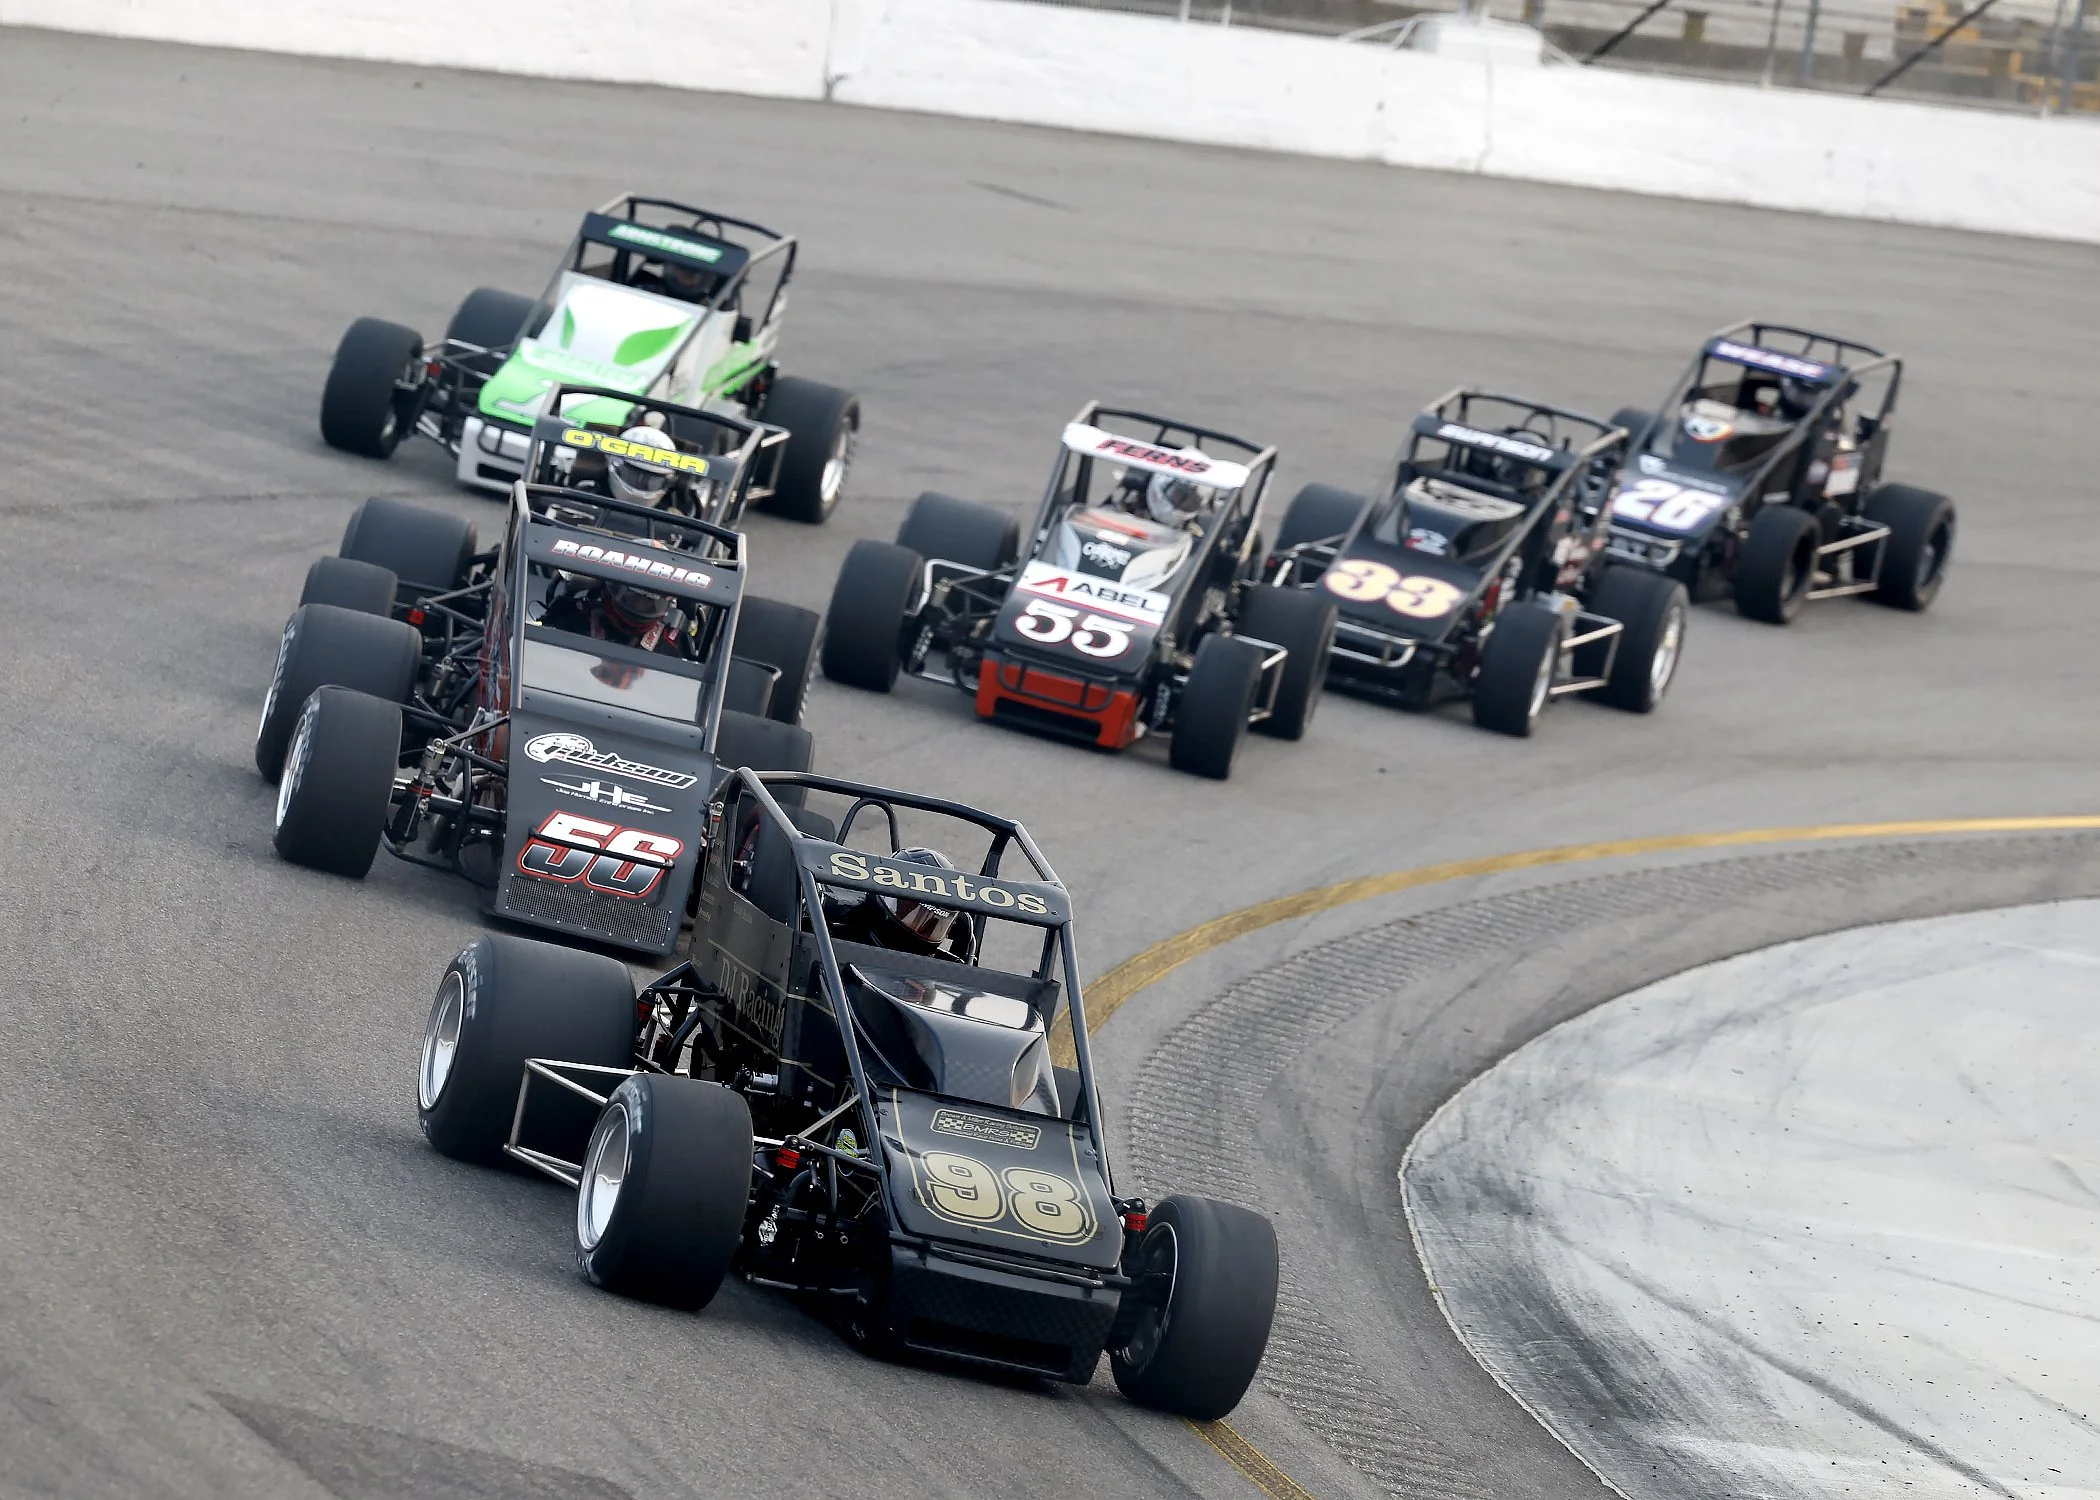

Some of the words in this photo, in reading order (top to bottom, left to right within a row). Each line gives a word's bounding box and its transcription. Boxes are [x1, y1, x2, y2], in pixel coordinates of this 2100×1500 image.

[563, 427, 708, 476] O'GARA
[1096, 439, 1212, 473] FERNS
[1612, 478, 1724, 532] 26
[551, 538, 713, 589] ROAHRIG
[1324, 557, 1463, 619] 33
[1071, 582, 1156, 613] ABEL
[1013, 597, 1137, 660] 55
[516, 809, 686, 899] 56
[829, 852, 1048, 915] Santos
[737, 971, 786, 1053] Racing
[963, 1123, 1010, 1137] BMRS
[919, 1150, 1090, 1240] 98
